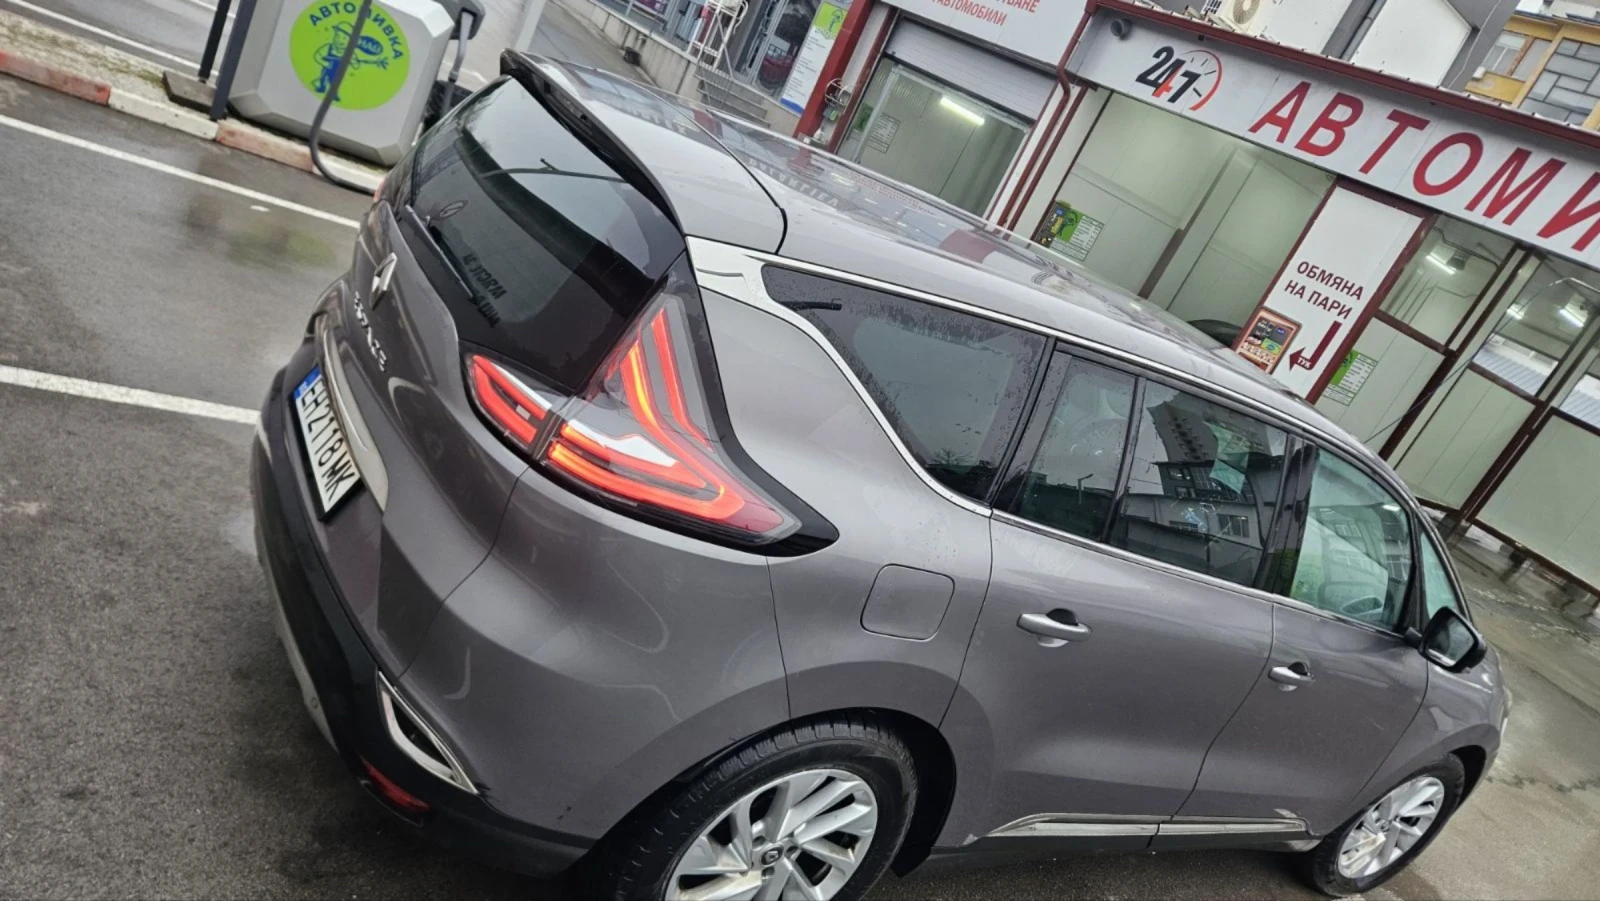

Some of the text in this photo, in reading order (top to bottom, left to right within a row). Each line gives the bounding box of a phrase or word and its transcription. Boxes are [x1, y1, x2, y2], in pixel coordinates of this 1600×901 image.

[309, 1, 403, 60] АВТОИВКА
[1284, 279, 1353, 320] НА ПАРИ
[1297, 261, 1364, 300] ОБМЯНА
[1297, 357, 1312, 370] ТУК
